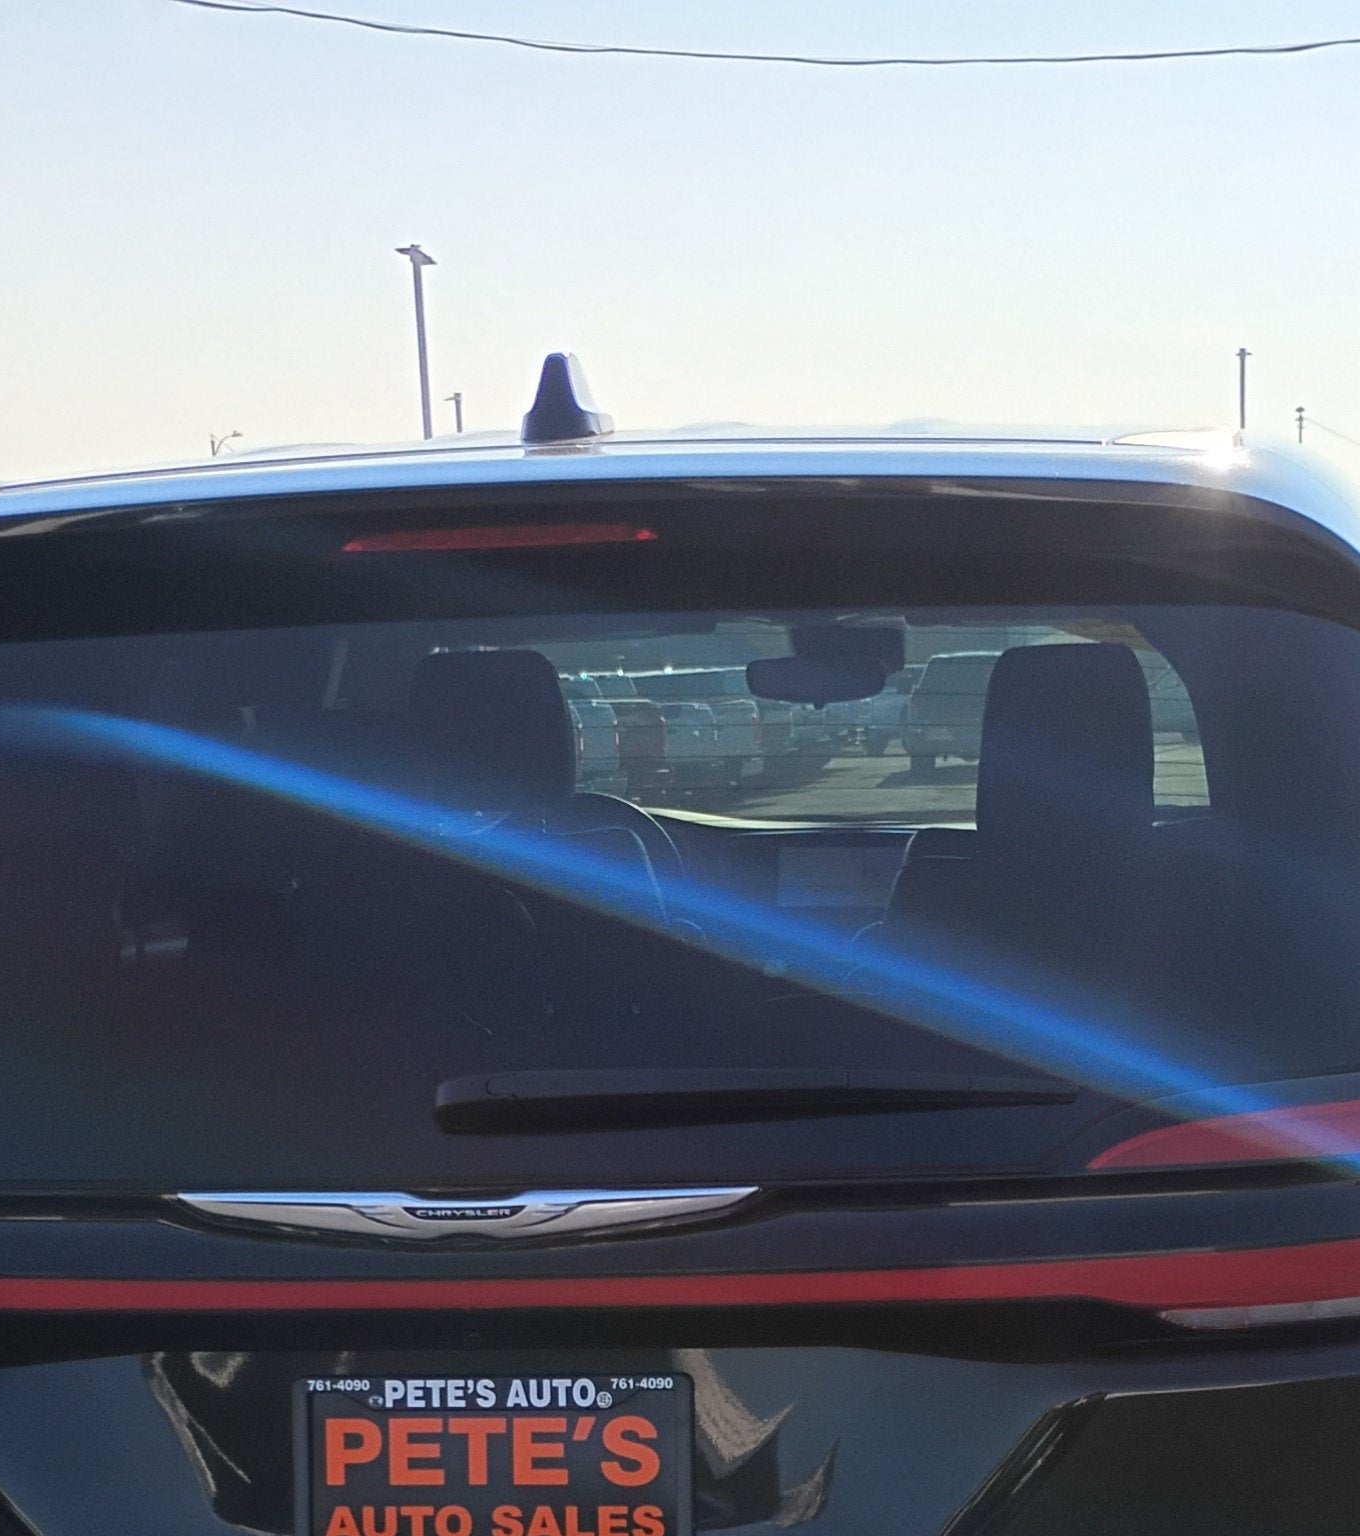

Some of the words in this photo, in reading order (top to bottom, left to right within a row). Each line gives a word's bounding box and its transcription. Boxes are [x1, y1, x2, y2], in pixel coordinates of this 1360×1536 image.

[415, 1208, 511, 1217] CHRYSLER
[307, 1379, 370, 1391] 761-4090
[610, 1376, 674, 1390] 761-4090
[384, 1378, 496, 1408] PETE'S
[506, 1377, 596, 1408] AUTO
[325, 1415, 660, 1487] PETE'S
